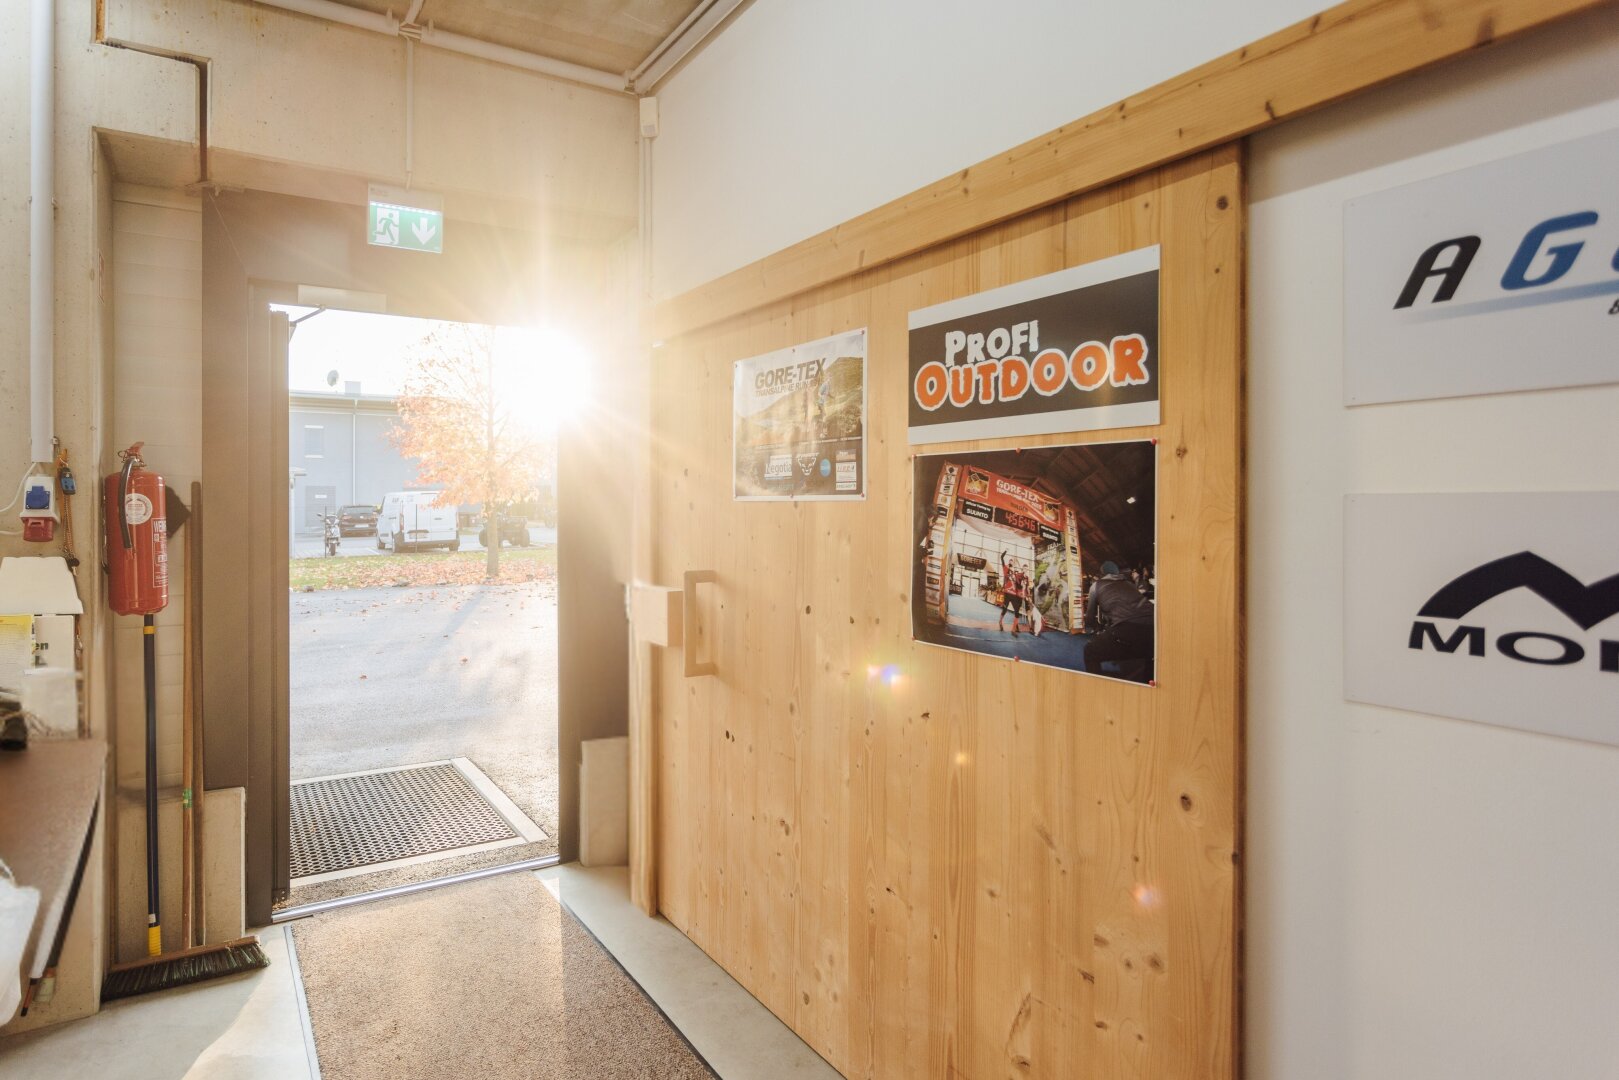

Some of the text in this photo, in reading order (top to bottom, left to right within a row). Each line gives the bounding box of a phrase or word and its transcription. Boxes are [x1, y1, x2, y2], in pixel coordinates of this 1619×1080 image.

[1393, 210, 1619, 310] AG
[754, 357, 826, 390] GORE-TEX
[996, 479, 1040, 502] GORE-TEX
[966, 508, 989, 519] SUUNTO
